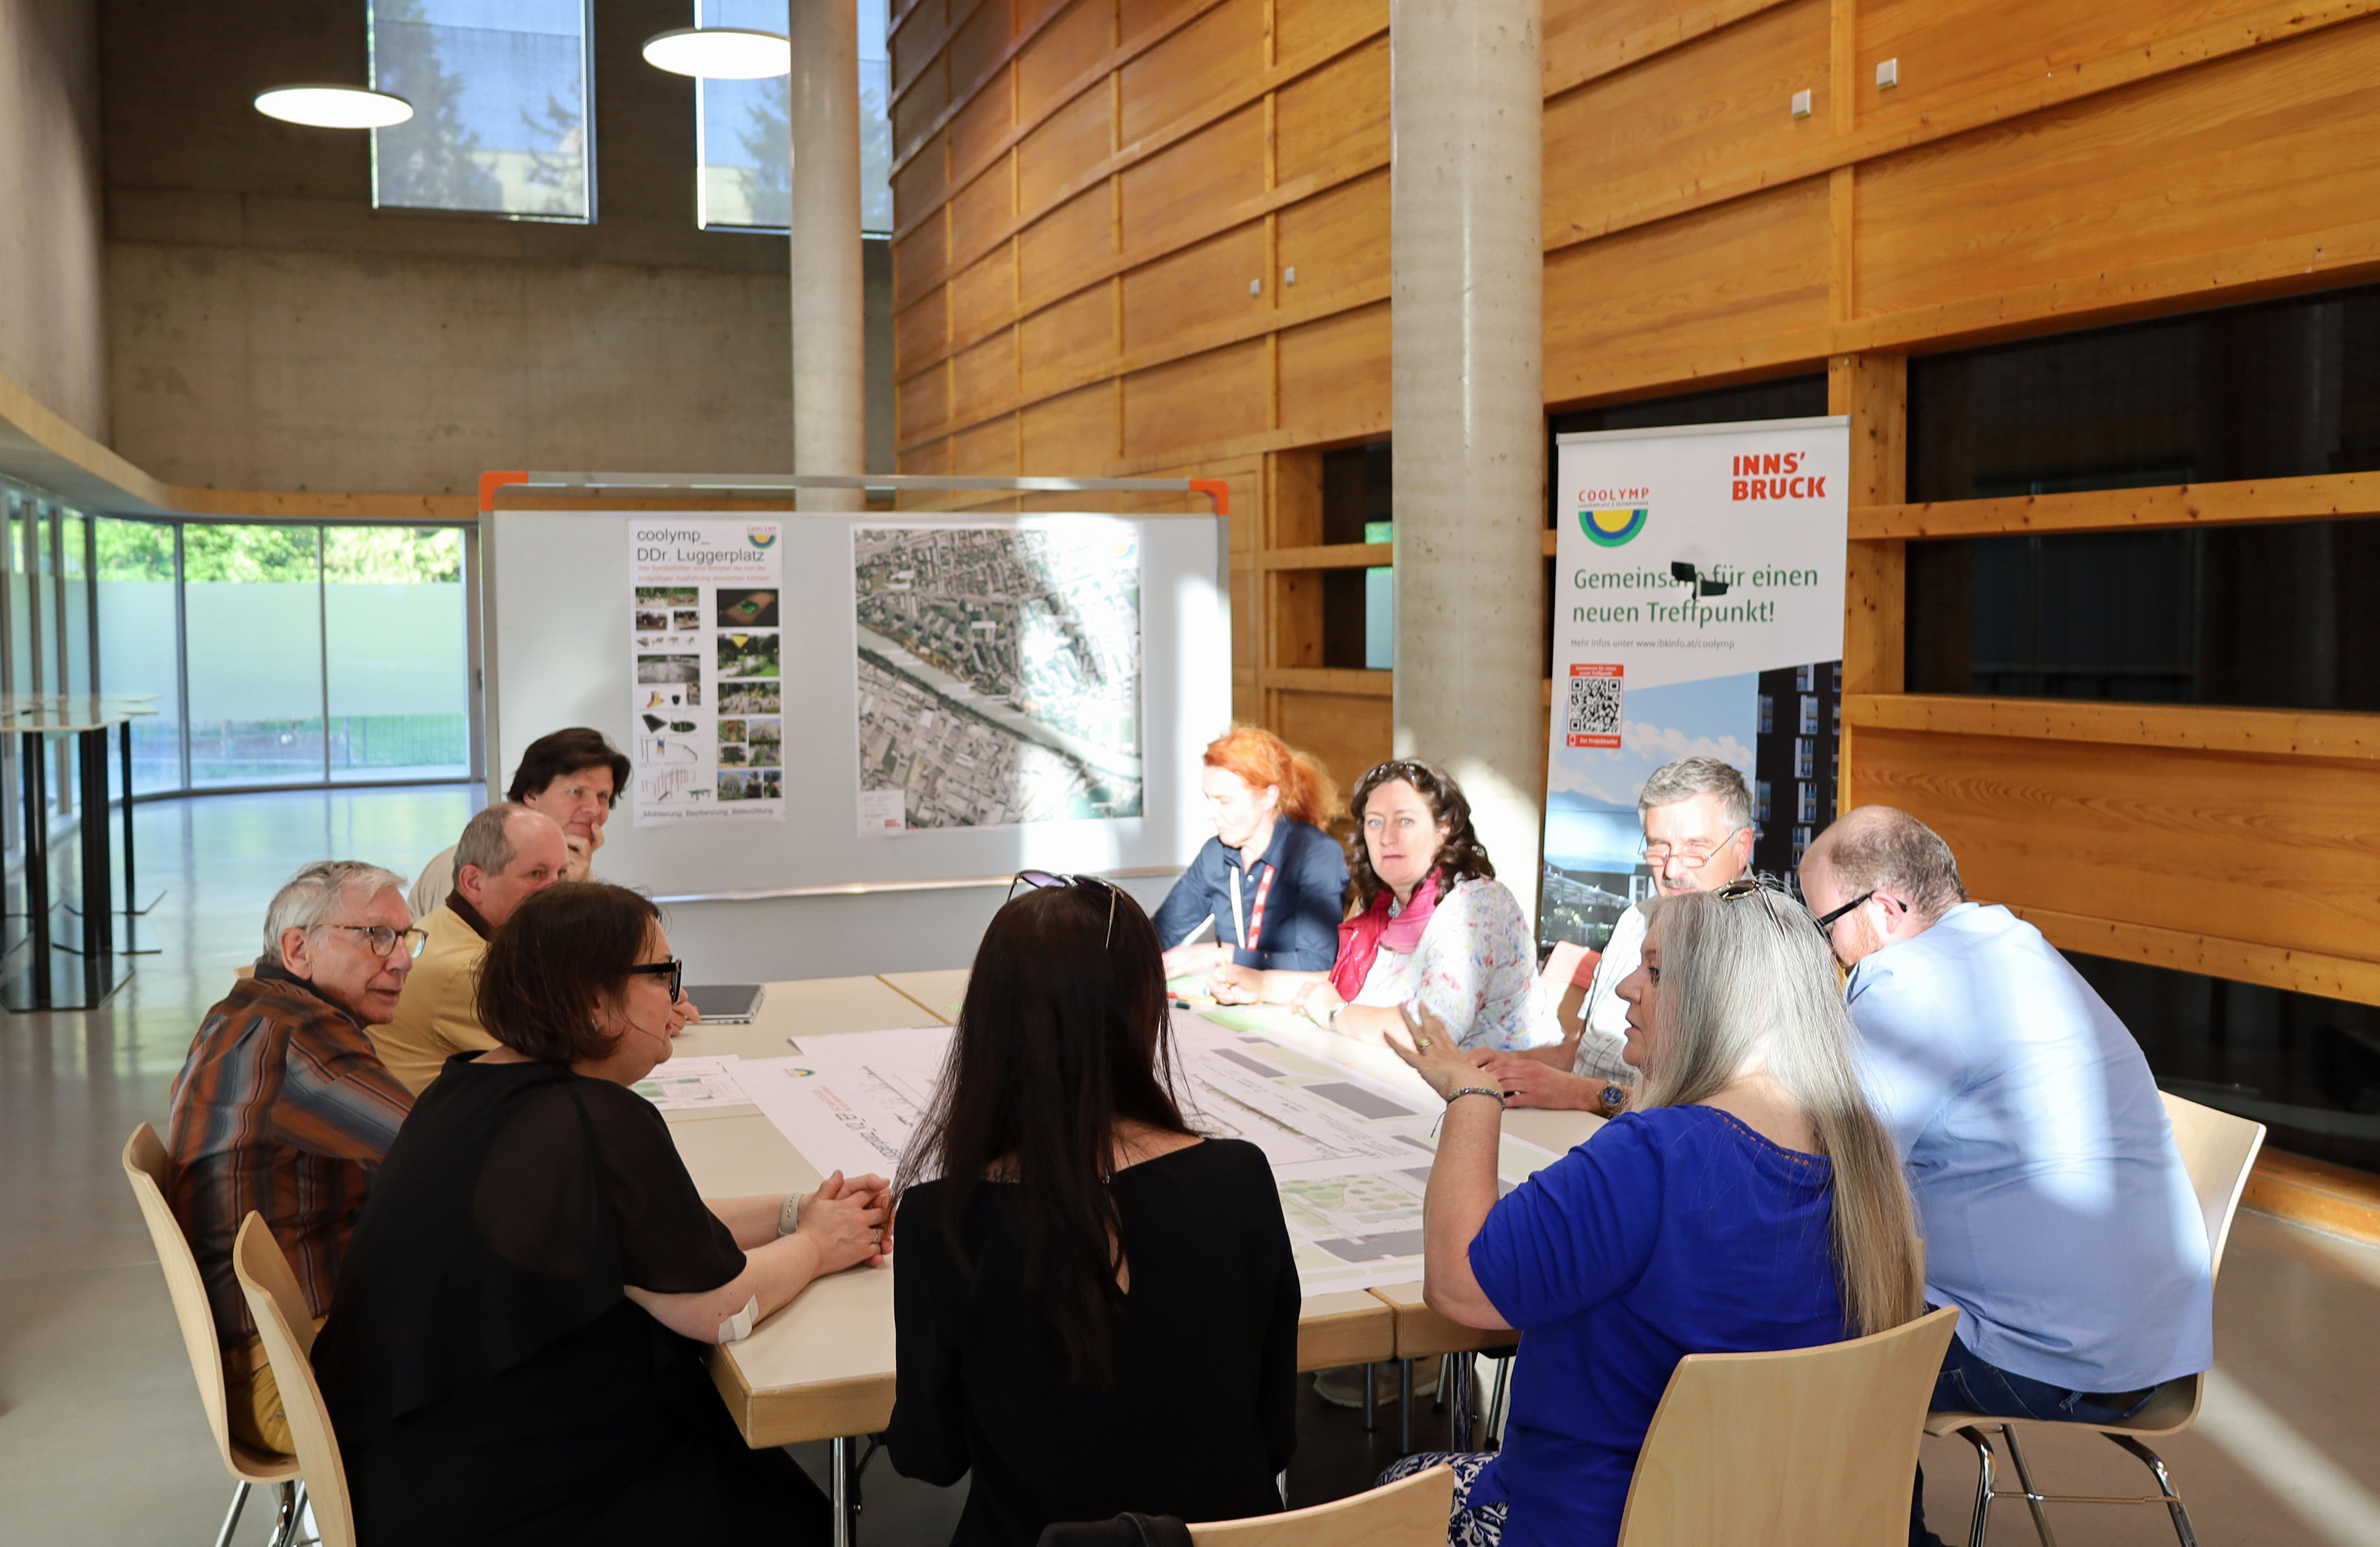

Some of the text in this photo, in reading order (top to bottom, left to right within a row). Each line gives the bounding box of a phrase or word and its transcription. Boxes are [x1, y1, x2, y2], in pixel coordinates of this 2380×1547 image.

[1733, 451, 1805, 476] INNS'
[1578, 487, 1649, 502] COOLYMP
[1732, 476, 1826, 500] BRUCK
[638, 548, 764, 564] DDr. Luggerplatz
[1713, 564, 1745, 586] für
[1752, 564, 1818, 586] einen
[1573, 600, 1774, 628] neuen Treffpunkt!
[1571, 639, 1589, 647] Mehr
[1613, 639, 1634, 647] unter
